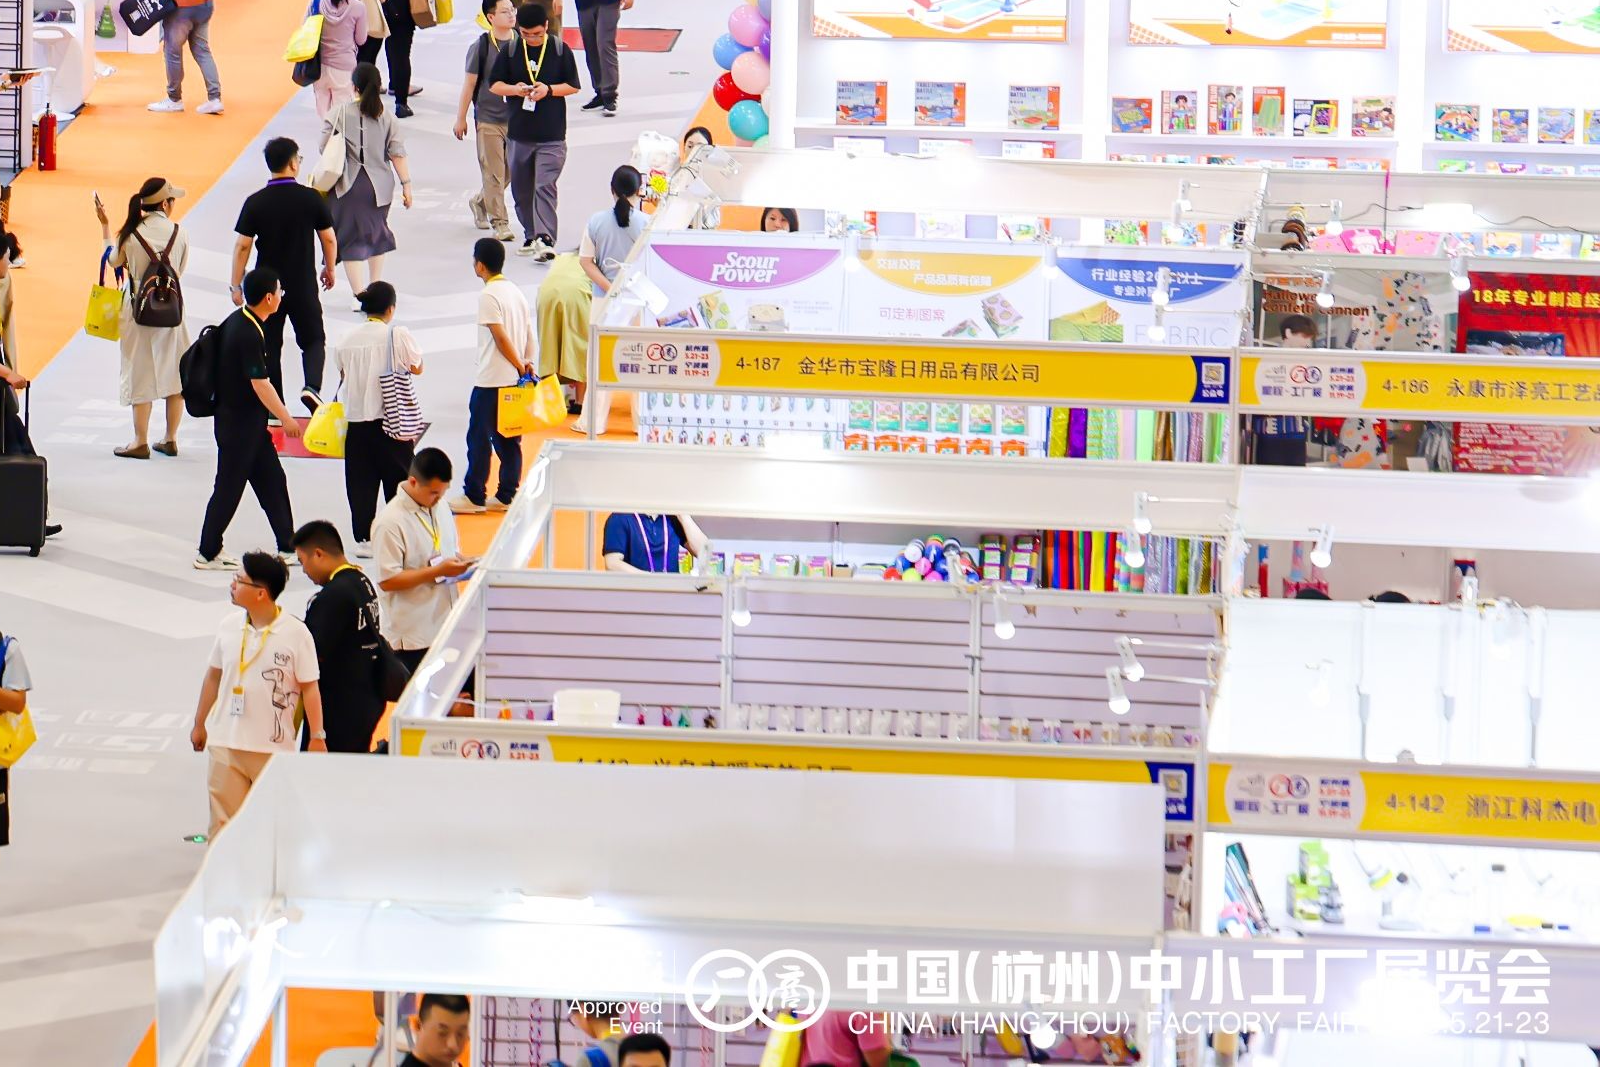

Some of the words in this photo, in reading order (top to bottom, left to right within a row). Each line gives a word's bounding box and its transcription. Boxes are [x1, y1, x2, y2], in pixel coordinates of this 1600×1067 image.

[724, 251, 780, 270] Scour
[709, 262, 778, 284] Power
[1134, 323, 1230, 346] FBRIC
[735, 356, 782, 372] 4-187
[798, 356, 1041, 385] 金华市宝隆日用品有限公司
[1382, 379, 1430, 394] 4-186
[1384, 793, 1446, 814] 4-142
[1465, 794, 1598, 826] 浙江科杰电
